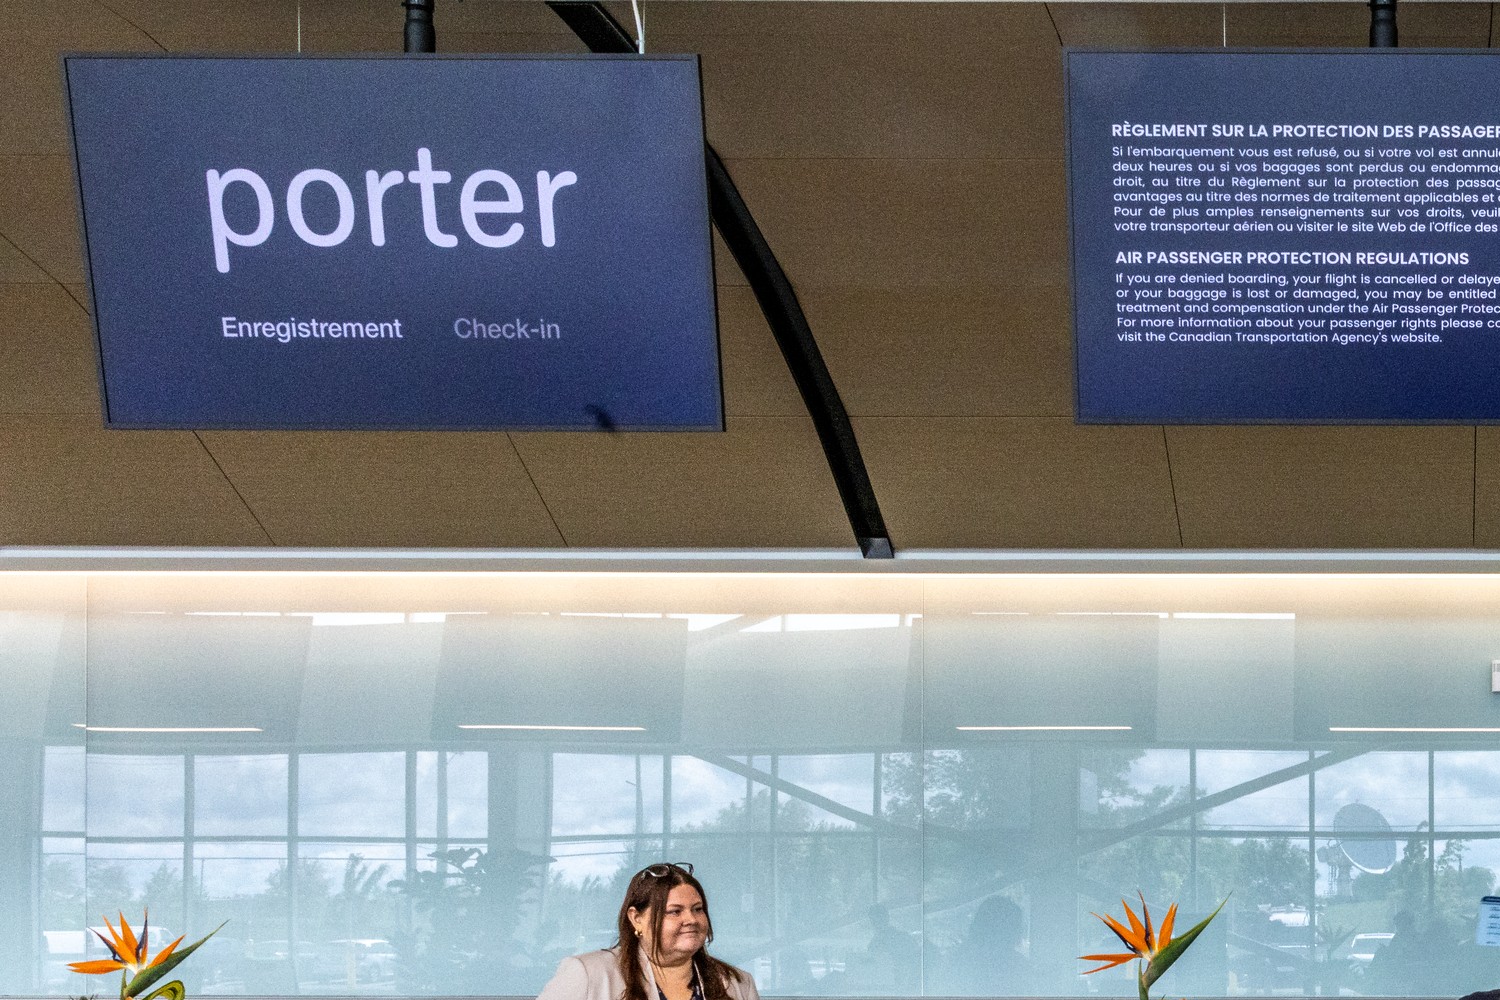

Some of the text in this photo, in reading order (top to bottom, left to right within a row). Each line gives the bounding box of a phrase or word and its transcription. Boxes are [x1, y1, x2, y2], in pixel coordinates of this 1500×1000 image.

[1112, 120, 1207, 137] RÈGLEMENT
[1212, 124, 1244, 137] SUR
[1249, 124, 1268, 137] LA
[1273, 125, 1378, 138] PROTECTION
[1383, 125, 1414, 138] DES
[1112, 146, 1123, 156] Si
[1127, 145, 1234, 159] l'embarquement
[1239, 148, 1269, 157] vous
[1273, 148, 1292, 157] est
[1297, 147, 1339, 158] refusé,
[1344, 149, 1360, 157] ou
[1364, 147, 1374, 157] si
[1378, 148, 1411, 158] votre
[1416, 147, 1434, 158] vol
[1438, 148, 1458, 158] est
[1112, 161, 1143, 171] deux
[1149, 161, 1193, 172] heures
[1198, 164, 1214, 172] ou
[1220, 161, 1229, 172] si
[1235, 163, 1257, 172] vos
[1263, 162, 1320, 175] bagages
[1326, 163, 1353, 172] sont
[1359, 162, 1404, 175] perdus
[1409, 164, 1425, 173] ou
[1113, 176, 1145, 187] droit,
[1152, 178, 1168, 187] au
[1176, 176, 1201, 187] titre
[1208, 176, 1224, 187] du
[1232, 176, 1300, 190] Règlement
[1308, 179, 1327, 187] sur
[1334, 177, 1346, 187] la
[1353, 177, 1419, 190] protection
[1426, 177, 1449, 188] des
[207, 148, 577, 273] porter
[1114, 206, 1142, 217] Pour
[1149, 206, 1166, 216] de
[1173, 206, 1199, 219] plus
[1206, 206, 1254, 219] amples
[1261, 206, 1364, 220] renseignements
[1371, 209, 1390, 217] sur
[1397, 209, 1419, 217] vos
[1426, 207, 1464, 218] droits,
[1114, 222, 1147, 231] votre
[1150, 222, 1230, 234] transporteur
[1233, 221, 1273, 232] aérien
[1277, 223, 1293, 232] ou
[1296, 221, 1334, 232] visiter
[1337, 221, 1348, 232] le
[1352, 221, 1374, 232] site
[1377, 222, 1406, 232] Web
[1409, 222, 1426, 232] de
[1429, 221, 1472, 232] l'Office
[1475, 222, 1498, 232] des
[1115, 251, 1469, 265] AIR PASSENGER PROTECTION REGULATIONS
[1116, 273, 1123, 283] If
[1127, 275, 1150, 286] you
[1155, 275, 1176, 283] are
[1180, 273, 1224, 284] denied
[1228, 273, 1289, 287] boarding,
[1293, 275, 1321, 286] your
[1325, 273, 1357, 287] flight
[1361, 274, 1370, 284] is
[1374, 274, 1437, 284] cancelled
[1441, 276, 1454, 284] or
[1116, 290, 1129, 298] or
[1134, 290, 1162, 301] your
[1168, 288, 1227, 301] baggage
[1232, 288, 1242, 298] is
[1247, 288, 1269, 298] lost
[1275, 290, 1288, 298] or
[1293, 288, 1359, 301] damaged,
[1364, 290, 1387, 301] you
[1393, 290, 1422, 301] may
[1427, 288, 1443, 299] be
[1449, 289, 1496, 299] entitled
[222, 316, 403, 344] Enregistrement
[454, 317, 561, 339] Check-in
[1117, 317, 1136, 327] For
[1141, 319, 1174, 327] more
[1178, 317, 1252, 327] information
[1256, 317, 1293, 328] about
[1298, 319, 1326, 330] your
[1330, 319, 1397, 331] passenger
[1401, 317, 1437, 331] rights
[1441, 318, 1483, 331] please
[1117, 331, 1442, 345] visit the Canadian Transportation Agency's website.
